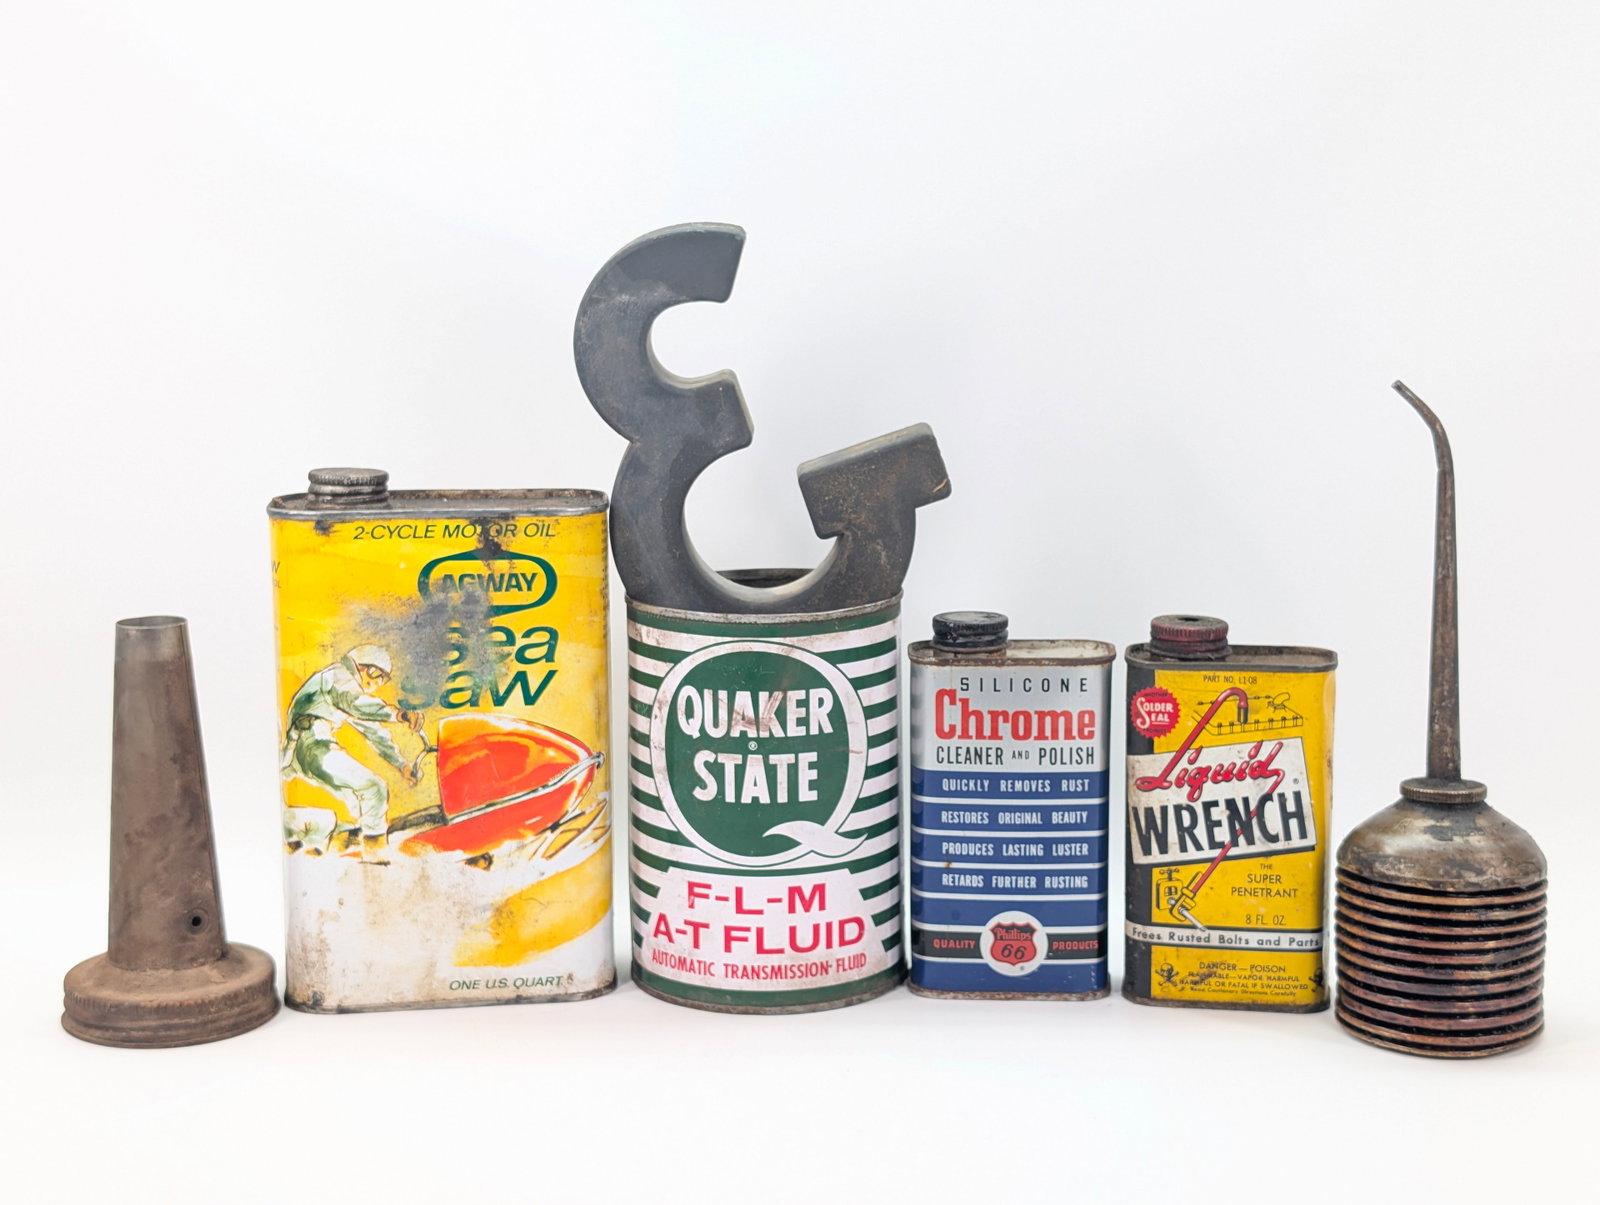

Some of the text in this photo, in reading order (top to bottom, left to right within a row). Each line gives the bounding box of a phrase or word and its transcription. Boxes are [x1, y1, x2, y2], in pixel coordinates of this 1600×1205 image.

[353, 524, 437, 540] 2-CYCLE
[523, 522, 556, 538] OIL
[960, 677, 1088, 692] SILICONE
[1203, 674, 1220, 683] PART
[676, 685, 834, 740] QUAKER
[935, 688, 1096, 741] Chrome
[1136, 697, 1174, 724] SOLDER
[936, 746, 1095, 765] CLEANER AND POLISH
[692, 750, 818, 804] STATE
[1135, 739, 1286, 803] Liquid
[942, 778, 1090, 792] QUICKLY REMOVES RUST
[941, 811, 1088, 825] RESTORES ORIGINAL BEAUTY
[1131, 790, 1308, 857] WRENCH
[942, 842, 1089, 857] PRODUCES LASTING LUSTER
[942, 874, 1088, 889] RETARDS FURTHER RUSTING
[1247, 873, 1282, 884] SUPER
[687, 881, 826, 915] F-L-M
[1231, 886, 1299, 898] PENETRANT
[1245, 913, 1252, 925] 8
[1272, 914, 1287, 926] OZ.
[653, 912, 866, 955] A-T FLUID
[994, 927, 1032, 941] Phillips
[1132, 927, 1320, 947] Frees Rusted Bolts and Parts
[933, 939, 1098, 950] QUALITY PRODUCTS
[1001, 943, 1027, 960] 66
[651, 948, 716, 977] AUTOMATIC
[836, 952, 868, 973] FLUID
[1199, 961, 1237, 971] DANGER
[1250, 964, 1286, 973] POISON
[449, 979, 481, 991] ONE
[513, 975, 563, 990] QUART
[1228, 981, 1249, 989] FATAL
